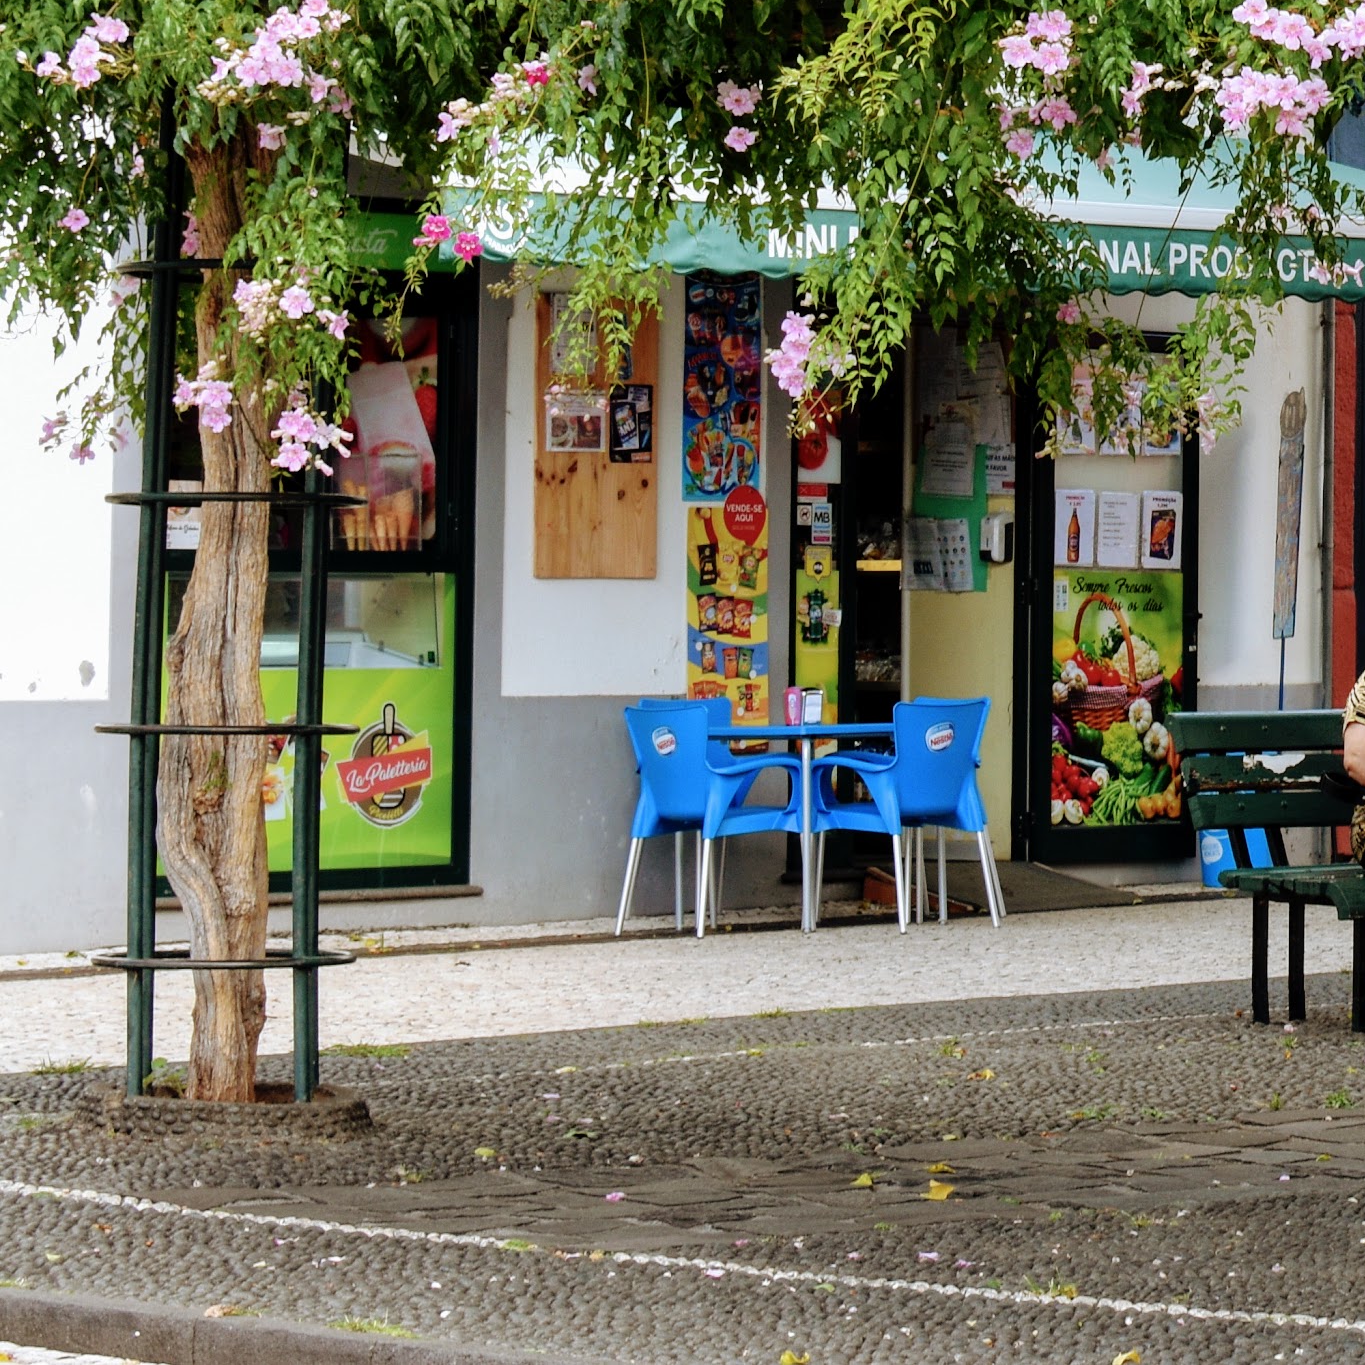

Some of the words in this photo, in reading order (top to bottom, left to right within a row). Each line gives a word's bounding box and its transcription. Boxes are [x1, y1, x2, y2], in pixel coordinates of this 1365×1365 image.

[768, 224, 838, 259] MINI
[726, 503, 763, 513] VENDE-SE
[734, 513, 754, 522] AQUI
[813, 511, 830, 523] MB
[1072, 576, 1110, 595] Sempre
[1115, 578, 1154, 594] Frescos
[1098, 597, 1123, 611] todos
[1127, 601, 1138, 611] os
[346, 769, 371, 793] La
[366, 757, 428, 786] Paletteria
